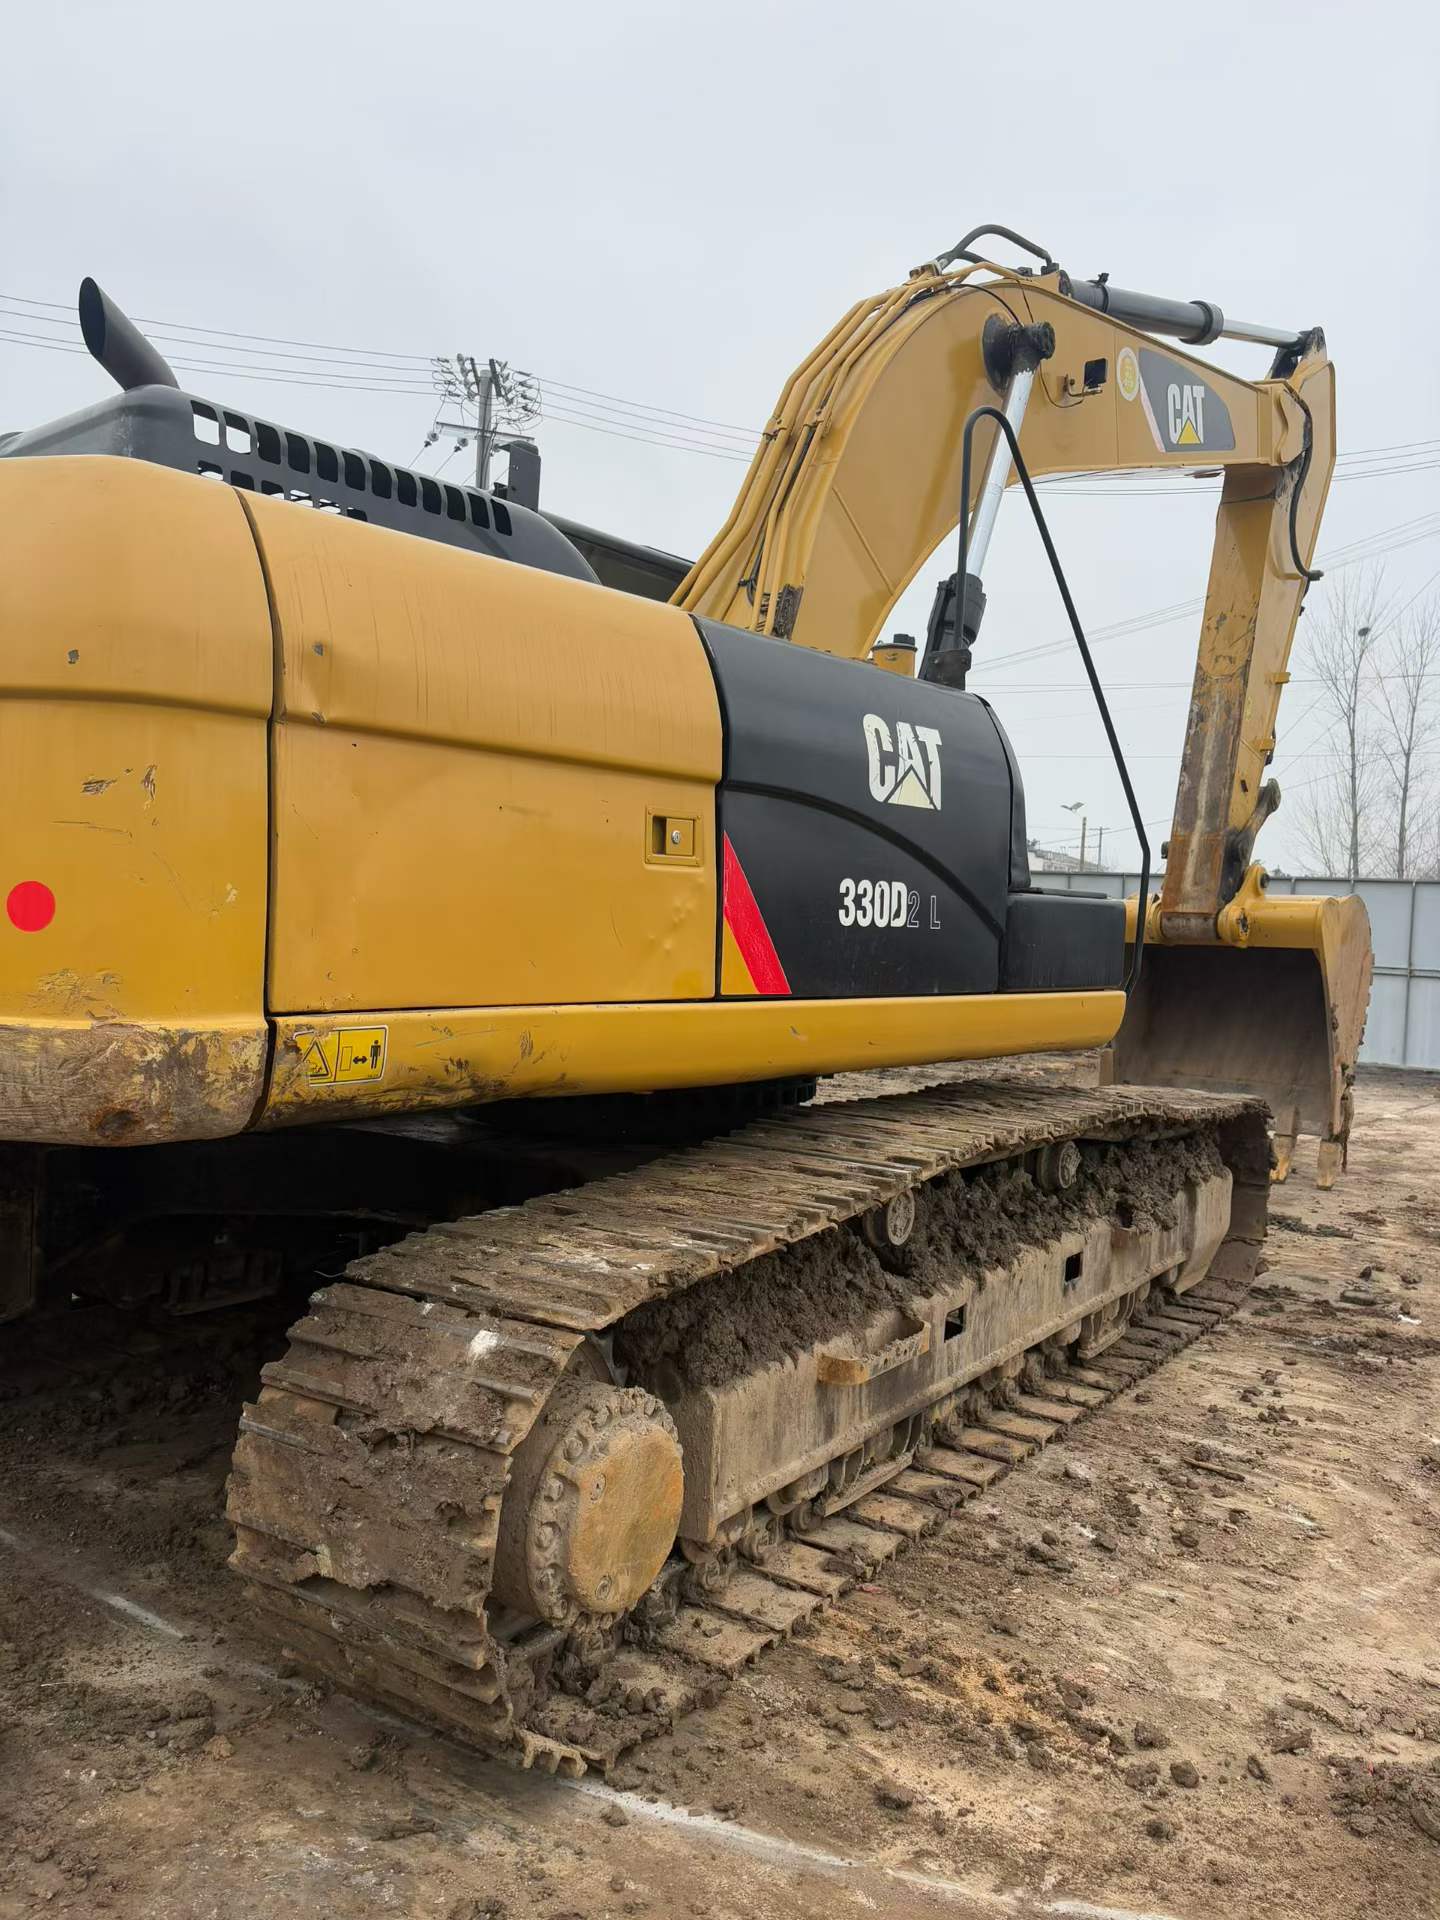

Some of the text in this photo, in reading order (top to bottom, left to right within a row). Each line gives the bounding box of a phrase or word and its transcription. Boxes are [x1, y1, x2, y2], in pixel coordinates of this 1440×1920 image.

[1167, 383, 1205, 445] CAT
[862, 713, 943, 811] CAT
[929, 895, 941, 930] L
